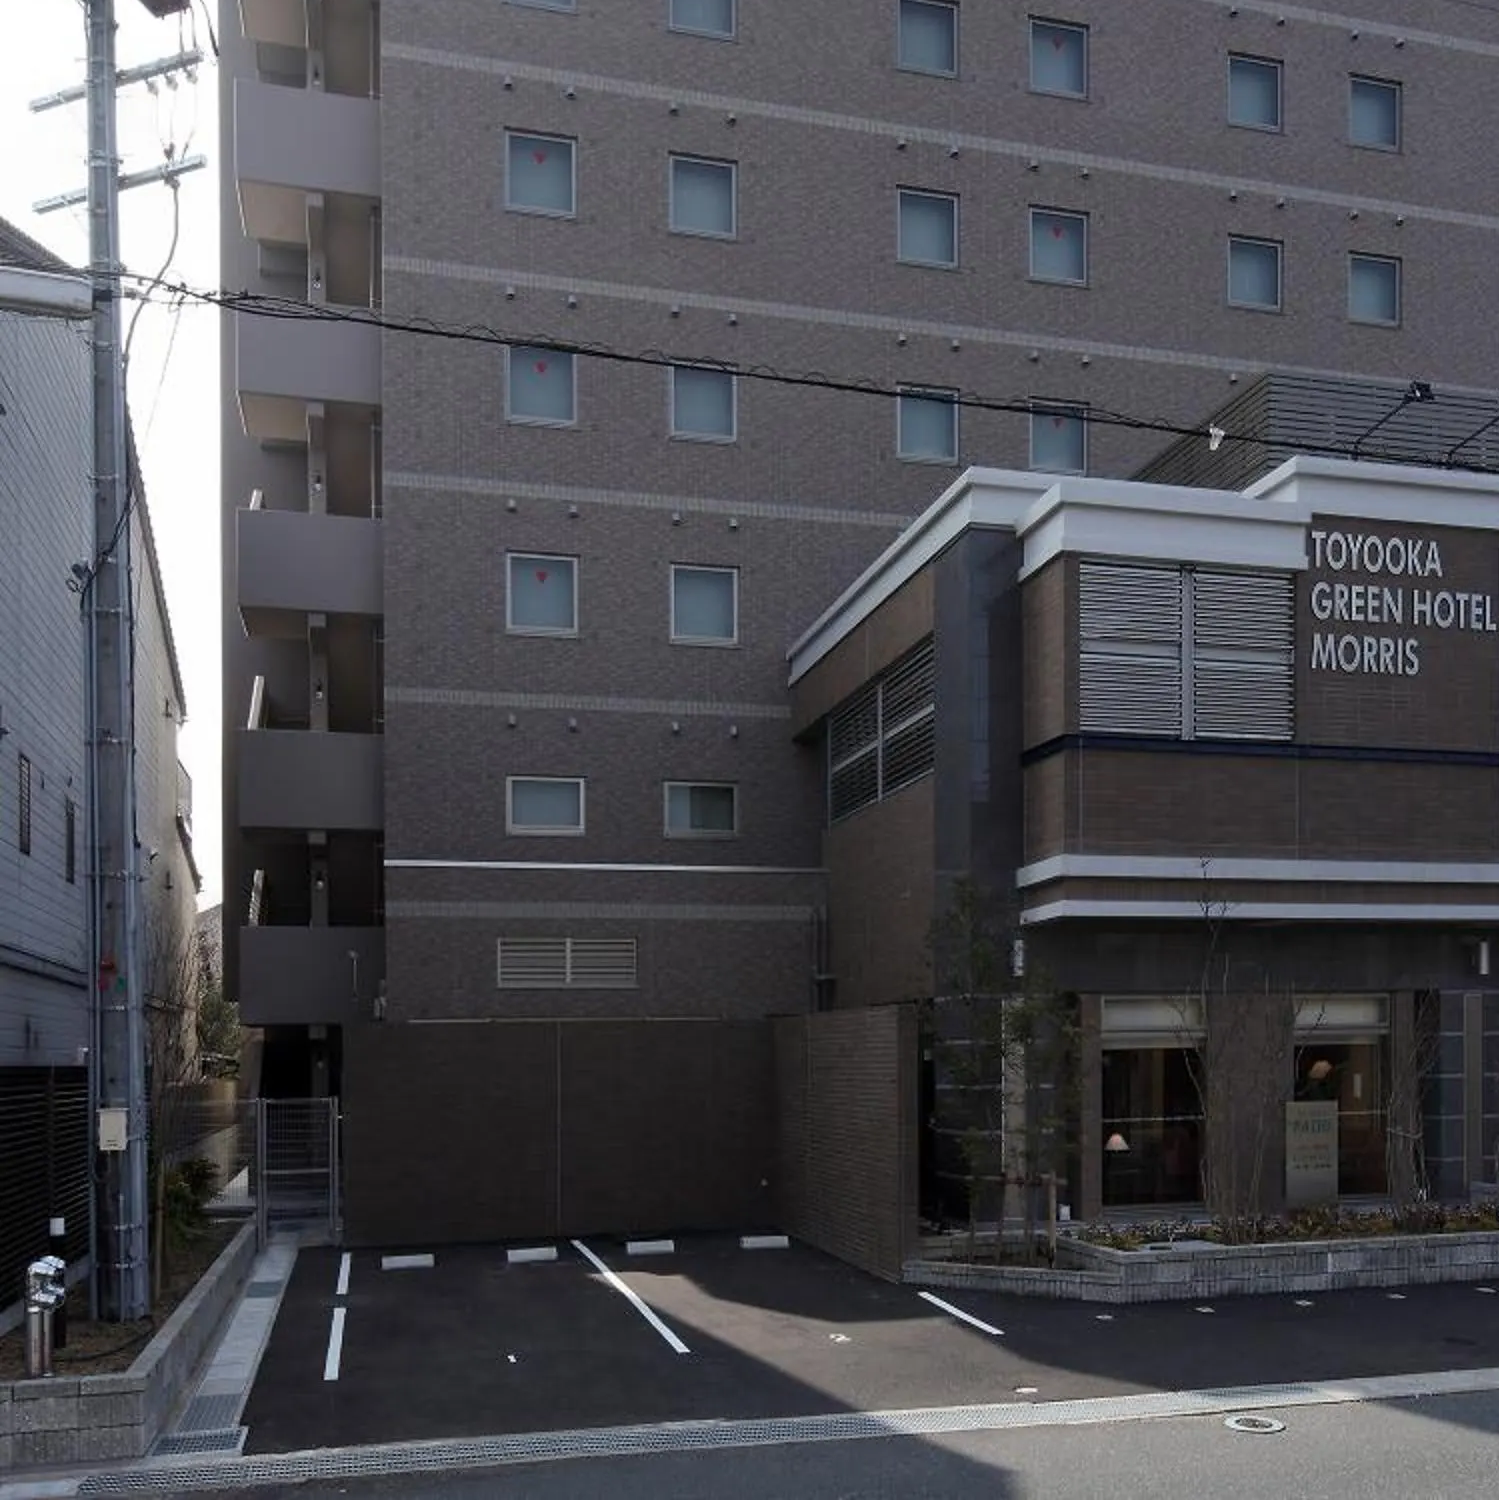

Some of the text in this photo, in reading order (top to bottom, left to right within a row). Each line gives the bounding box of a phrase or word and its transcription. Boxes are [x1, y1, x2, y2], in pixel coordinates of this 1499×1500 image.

[1311, 530, 1443, 577] TOYOOKA
[1311, 581, 1497, 632] GREEN HOTEL
[1311, 632, 1420, 675] MORRIS
